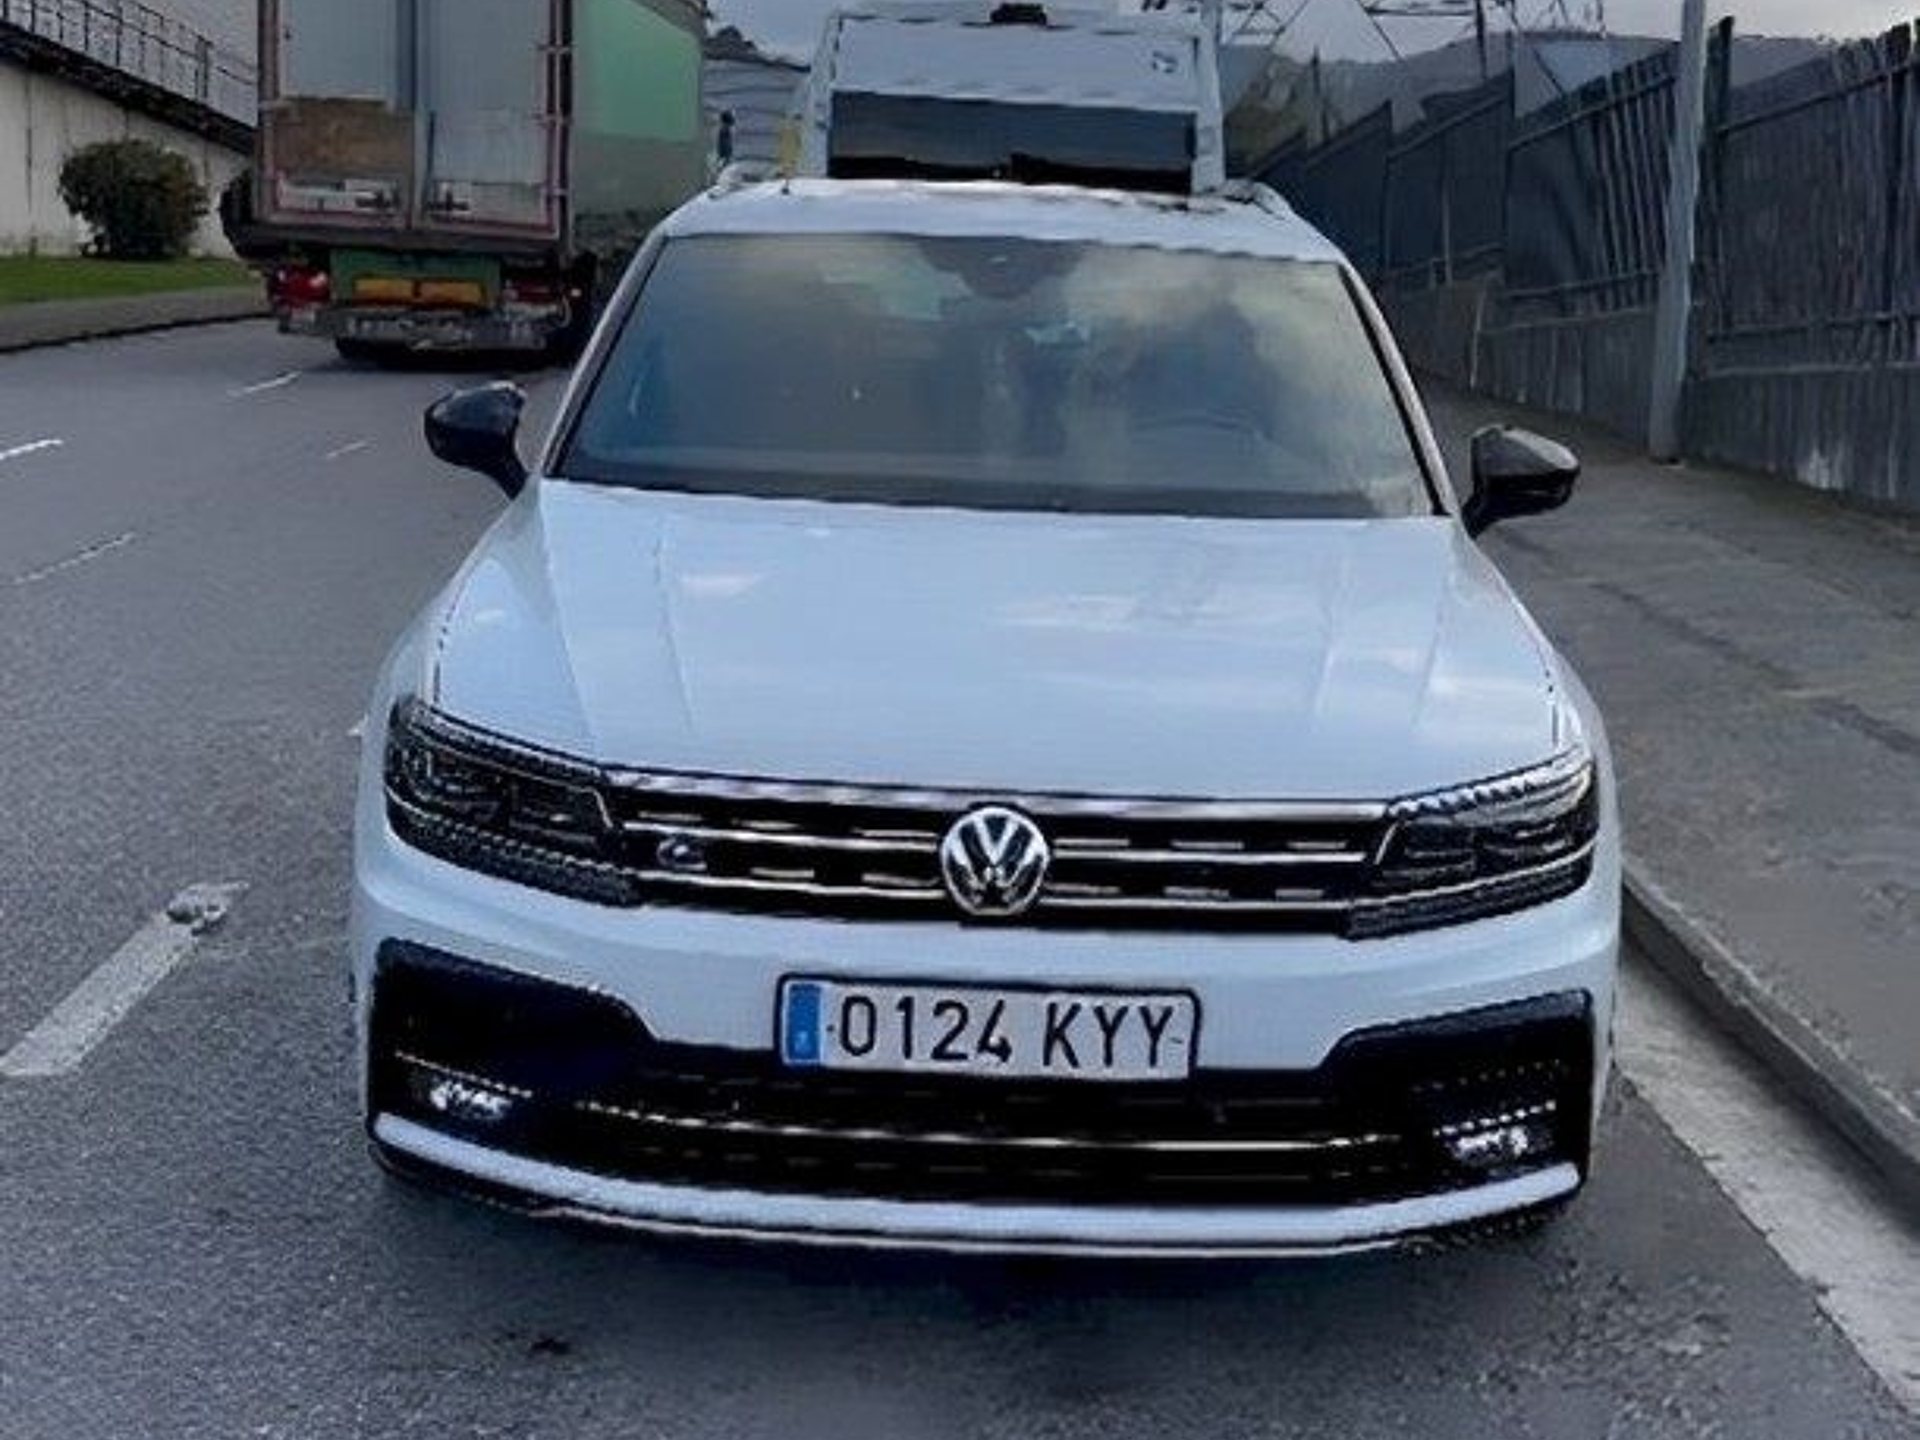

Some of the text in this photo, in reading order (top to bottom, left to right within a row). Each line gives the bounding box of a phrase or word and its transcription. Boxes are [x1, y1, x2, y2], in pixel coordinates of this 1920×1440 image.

[941, 807, 1049, 914] VW
[839, 995, 1173, 1069] 0124 KYY
